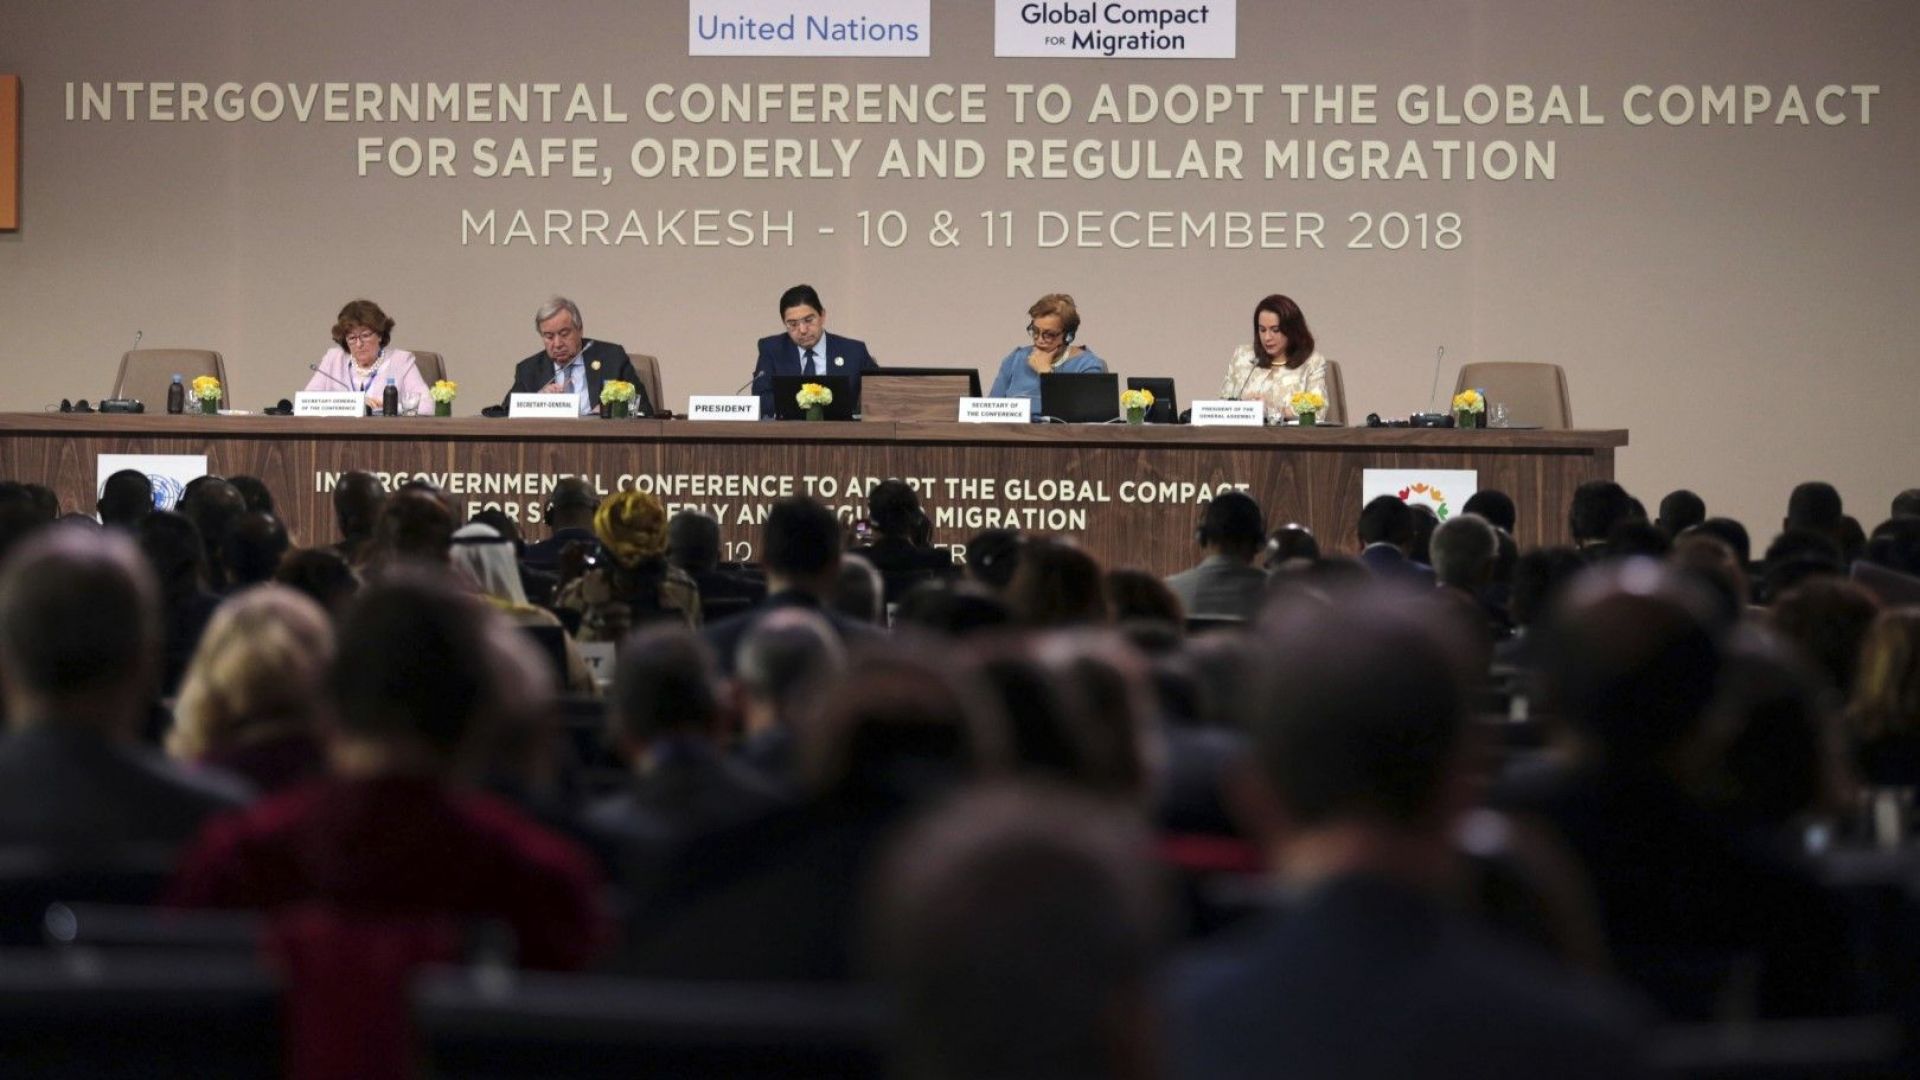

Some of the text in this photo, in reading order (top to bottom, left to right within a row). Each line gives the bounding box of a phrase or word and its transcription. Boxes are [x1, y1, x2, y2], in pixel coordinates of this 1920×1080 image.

[698, 14, 919, 42] United Nations
[1021, 2, 1210, 30] Global Compact
[1045, 30, 1185, 57] FOR Migration
[64, 82, 1880, 126] INTERGOVERNMENTAL CONFERENCE TO ADOPT THE GLOBAL COMPACT
[357, 137, 1556, 186] FOR SAFE, ORDERLY AND REGULAR MIGRATION
[462, 209, 795, 248] MARRAKESH
[857, 210, 908, 248] 10
[929, 210, 960, 248] &
[981, 211, 1013, 248] 11
[1038, 211, 1325, 250] DECEMBER
[1347, 212, 1463, 251] 2018
[516, 401, 572, 409] SECRETARY-GENERAL
[695, 404, 752, 413] PRESIDENT
[980, 410, 1023, 418] CONFERENCE
[315, 471, 609, 495] INRGVERNMENL
[616, 473, 794, 497] CONFERENCE
[803, 475, 838, 498] TO
[845, 476, 937, 499] ADPT
[944, 477, 995, 500] THE
[1004, 479, 1111, 502] GLOBAL
[935, 505, 1086, 531] MIGRATION
[724, 541, 752, 562] 10
